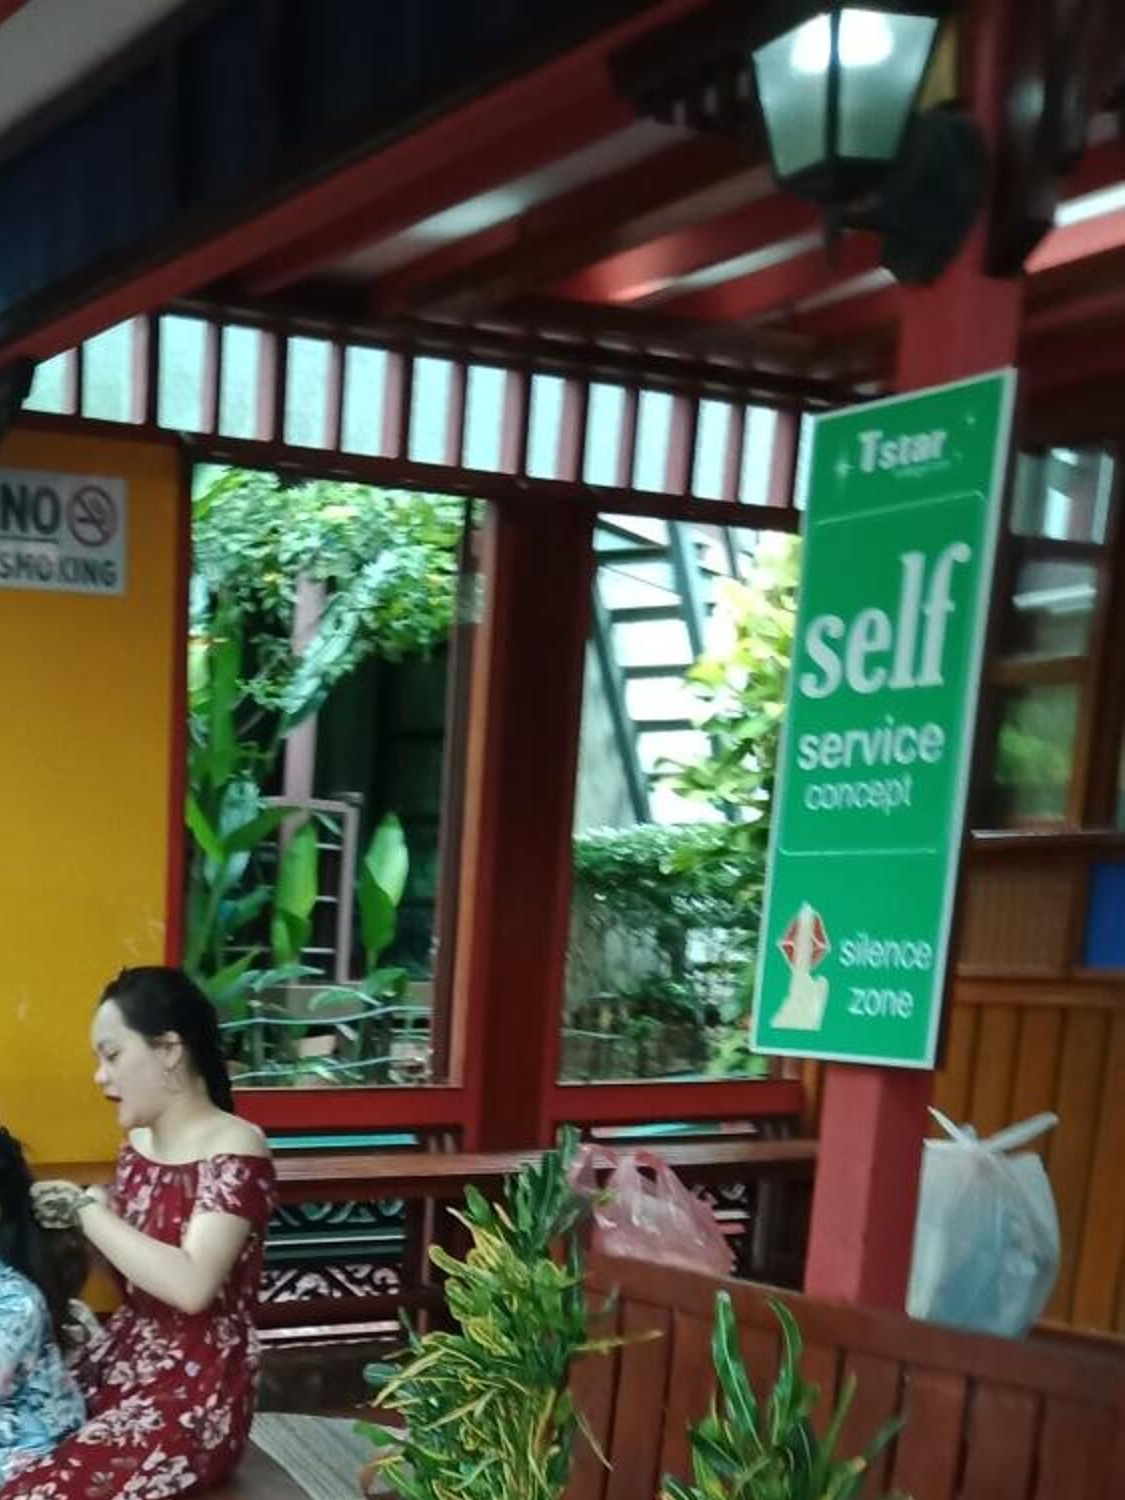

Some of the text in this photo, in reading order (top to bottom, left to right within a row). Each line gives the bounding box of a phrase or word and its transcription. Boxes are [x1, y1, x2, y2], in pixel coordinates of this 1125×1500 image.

[0, 484, 60, 535] NO
[799, 542, 972, 699] self
[797, 713, 946, 771] service
[804, 773, 912, 816] concept
[838, 932, 933, 970] silence
[848, 987, 915, 1019] zone
